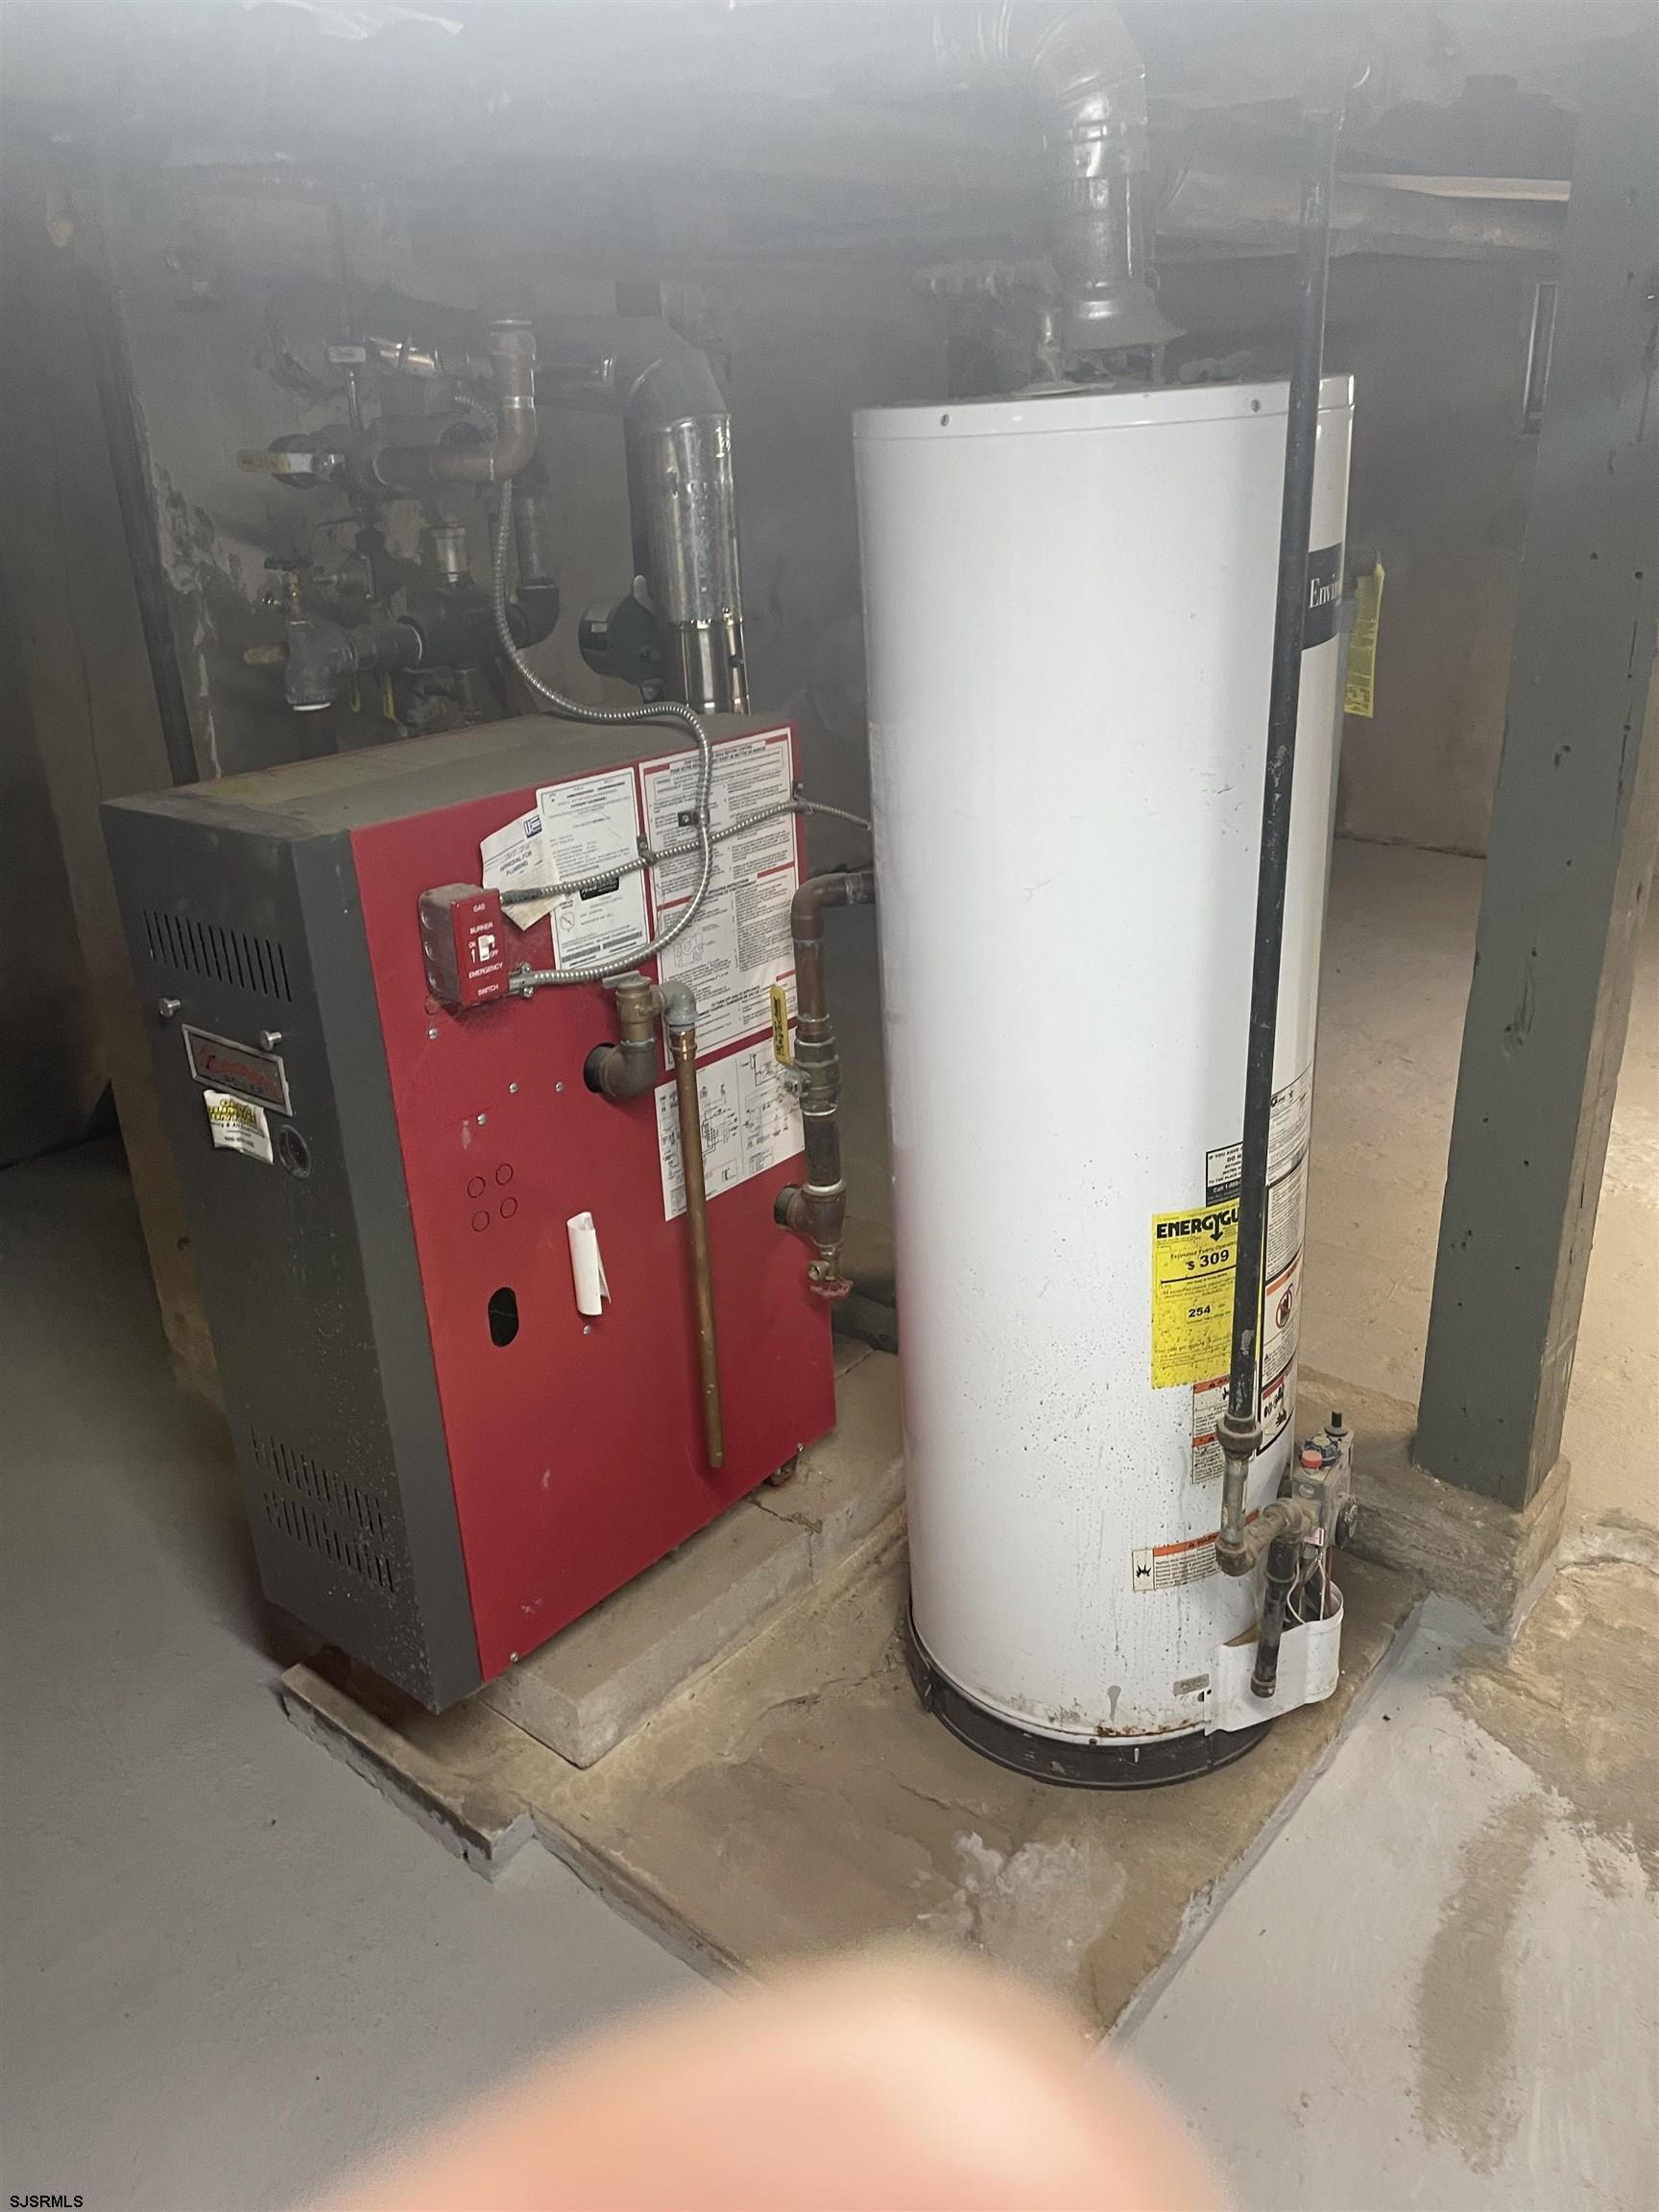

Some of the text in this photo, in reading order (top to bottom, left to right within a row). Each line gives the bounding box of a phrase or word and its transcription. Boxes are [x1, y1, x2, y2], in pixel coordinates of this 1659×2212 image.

[1309, 572, 1340, 609] Envi
[473, 902, 486, 913] GAS
[469, 922, 493, 935] BURNER
[469, 962, 503, 979] EMERGENCY
[478, 984, 499, 996] SWITCH
[1199, 1249, 1230, 1267] 309
[1188, 1305, 1212, 1318] 254
